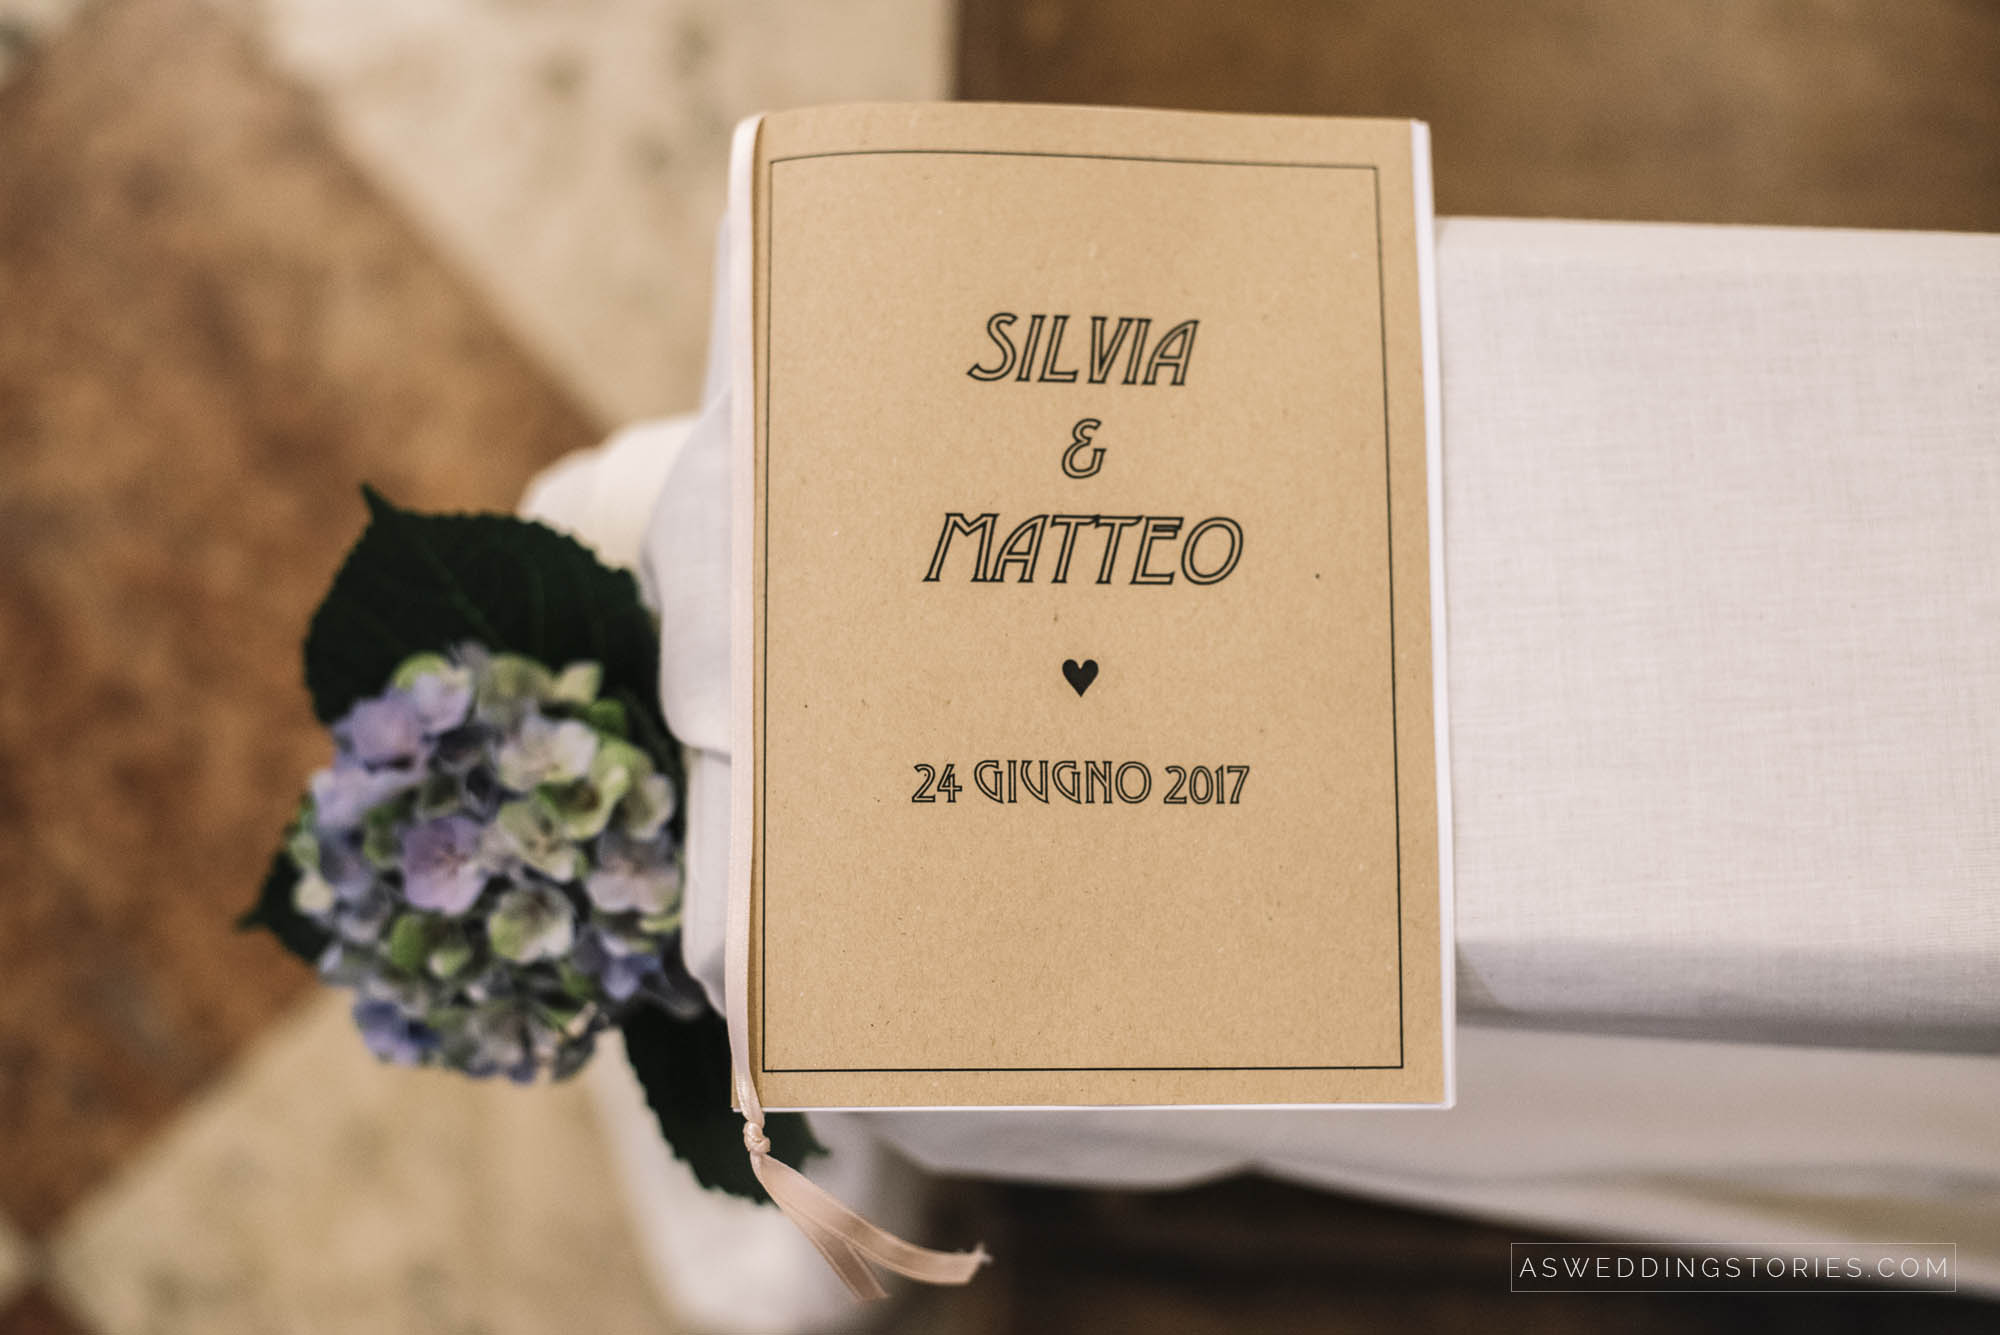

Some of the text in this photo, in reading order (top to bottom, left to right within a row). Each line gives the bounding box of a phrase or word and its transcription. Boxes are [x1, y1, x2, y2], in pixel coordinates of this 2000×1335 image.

[966, 312, 1199, 386] SILVIA
[1061, 418, 1107, 479] &
[922, 512, 1244, 586] MATTEO
[911, 759, 1250, 805] 24 GIUGNO 2017
